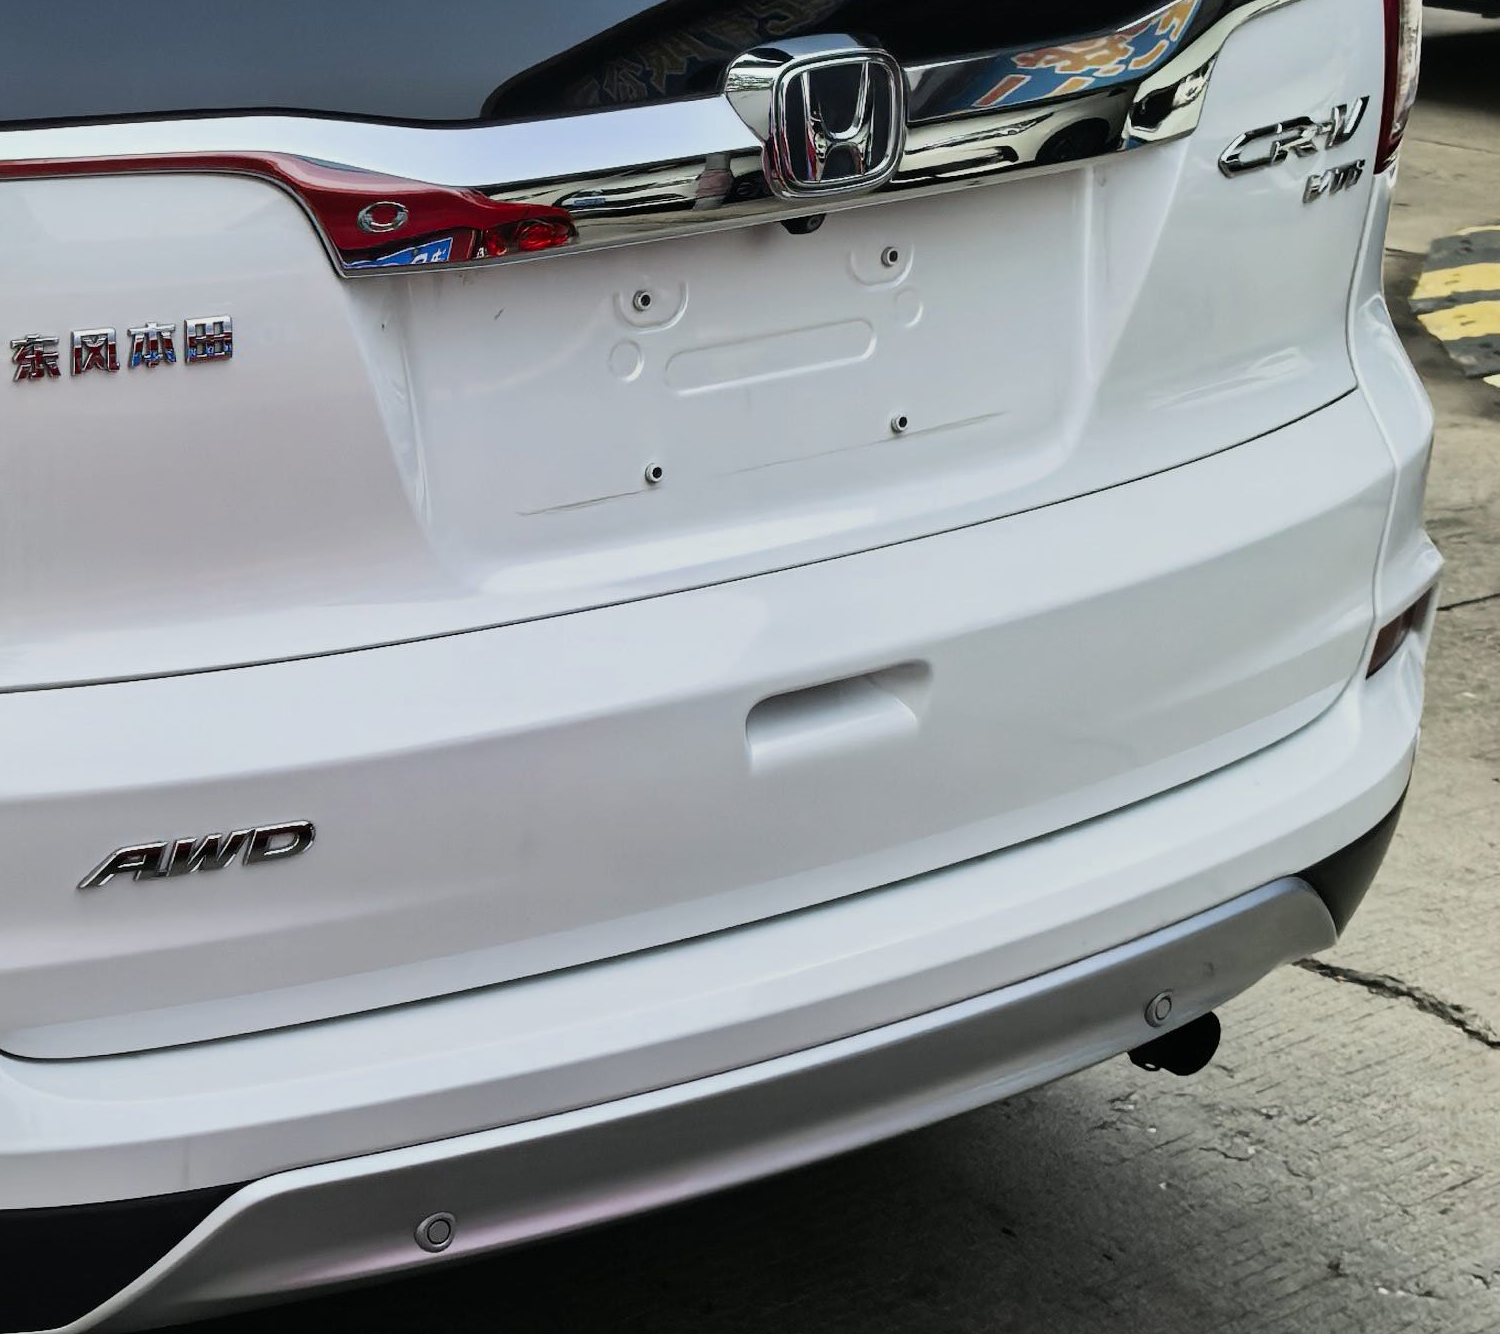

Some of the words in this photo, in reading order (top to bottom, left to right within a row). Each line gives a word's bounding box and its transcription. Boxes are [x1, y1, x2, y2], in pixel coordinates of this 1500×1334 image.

[1217, 95, 1370, 179] CR-V
[10, 314, 233, 382] 东风本田
[76, 820, 316, 890] AWD
